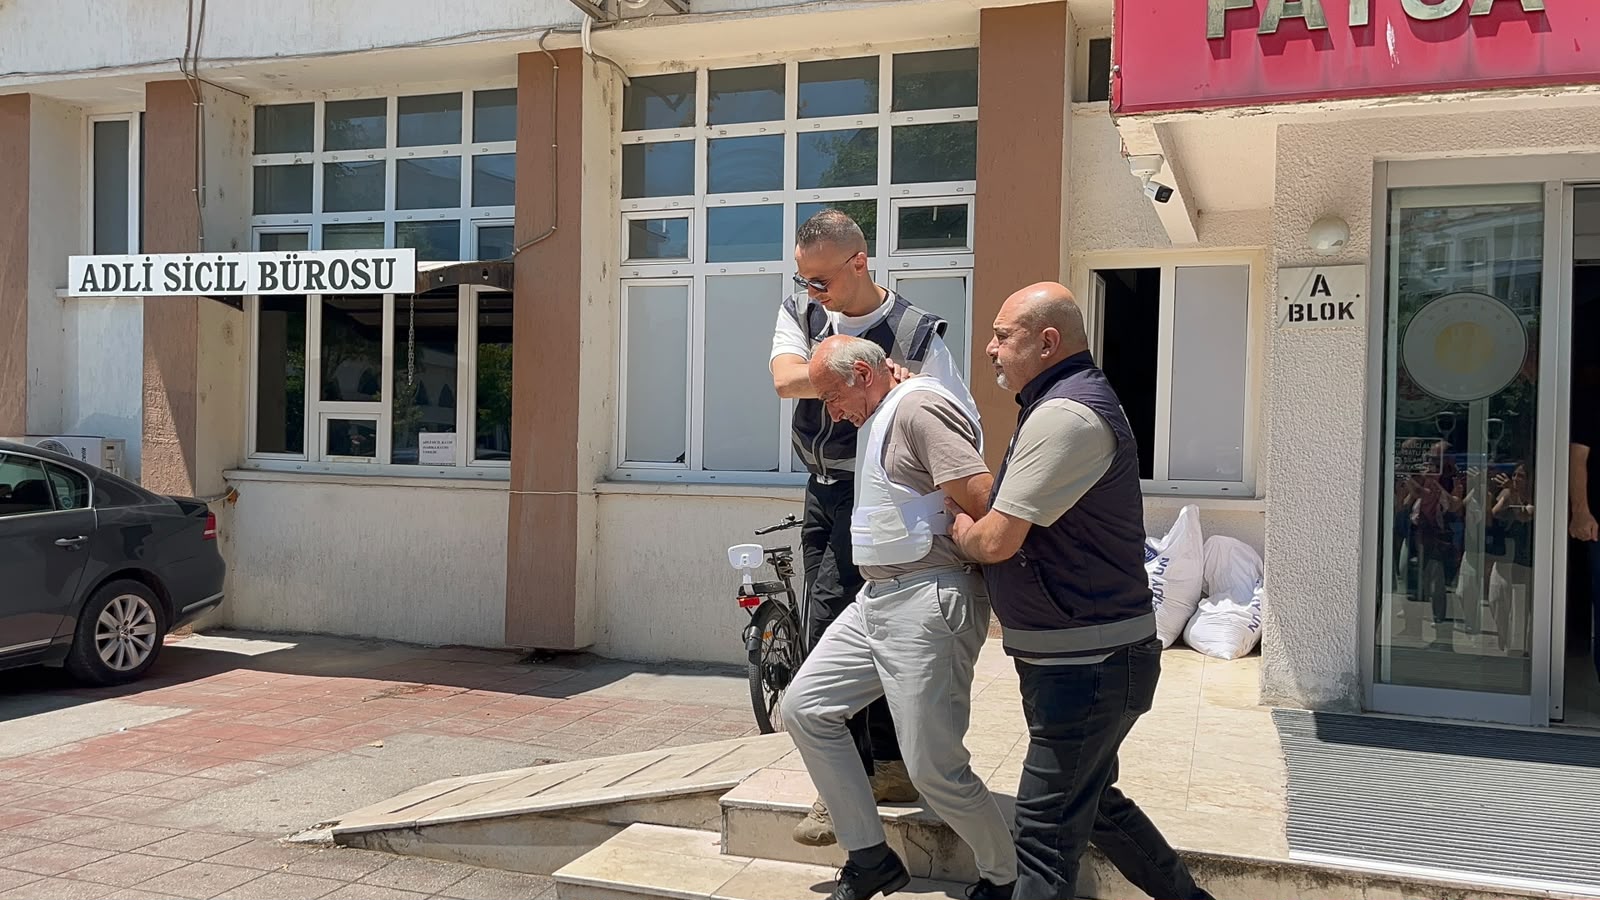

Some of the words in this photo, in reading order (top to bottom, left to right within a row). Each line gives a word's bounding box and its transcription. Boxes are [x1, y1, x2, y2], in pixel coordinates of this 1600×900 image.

[79, 256, 154, 293] ADLİ
[163, 255, 247, 292] SİCİL
[258, 254, 397, 291] BÜROSU
[1309, 273, 1332, 297] A
[1288, 301, 1355, 323] BLOK
